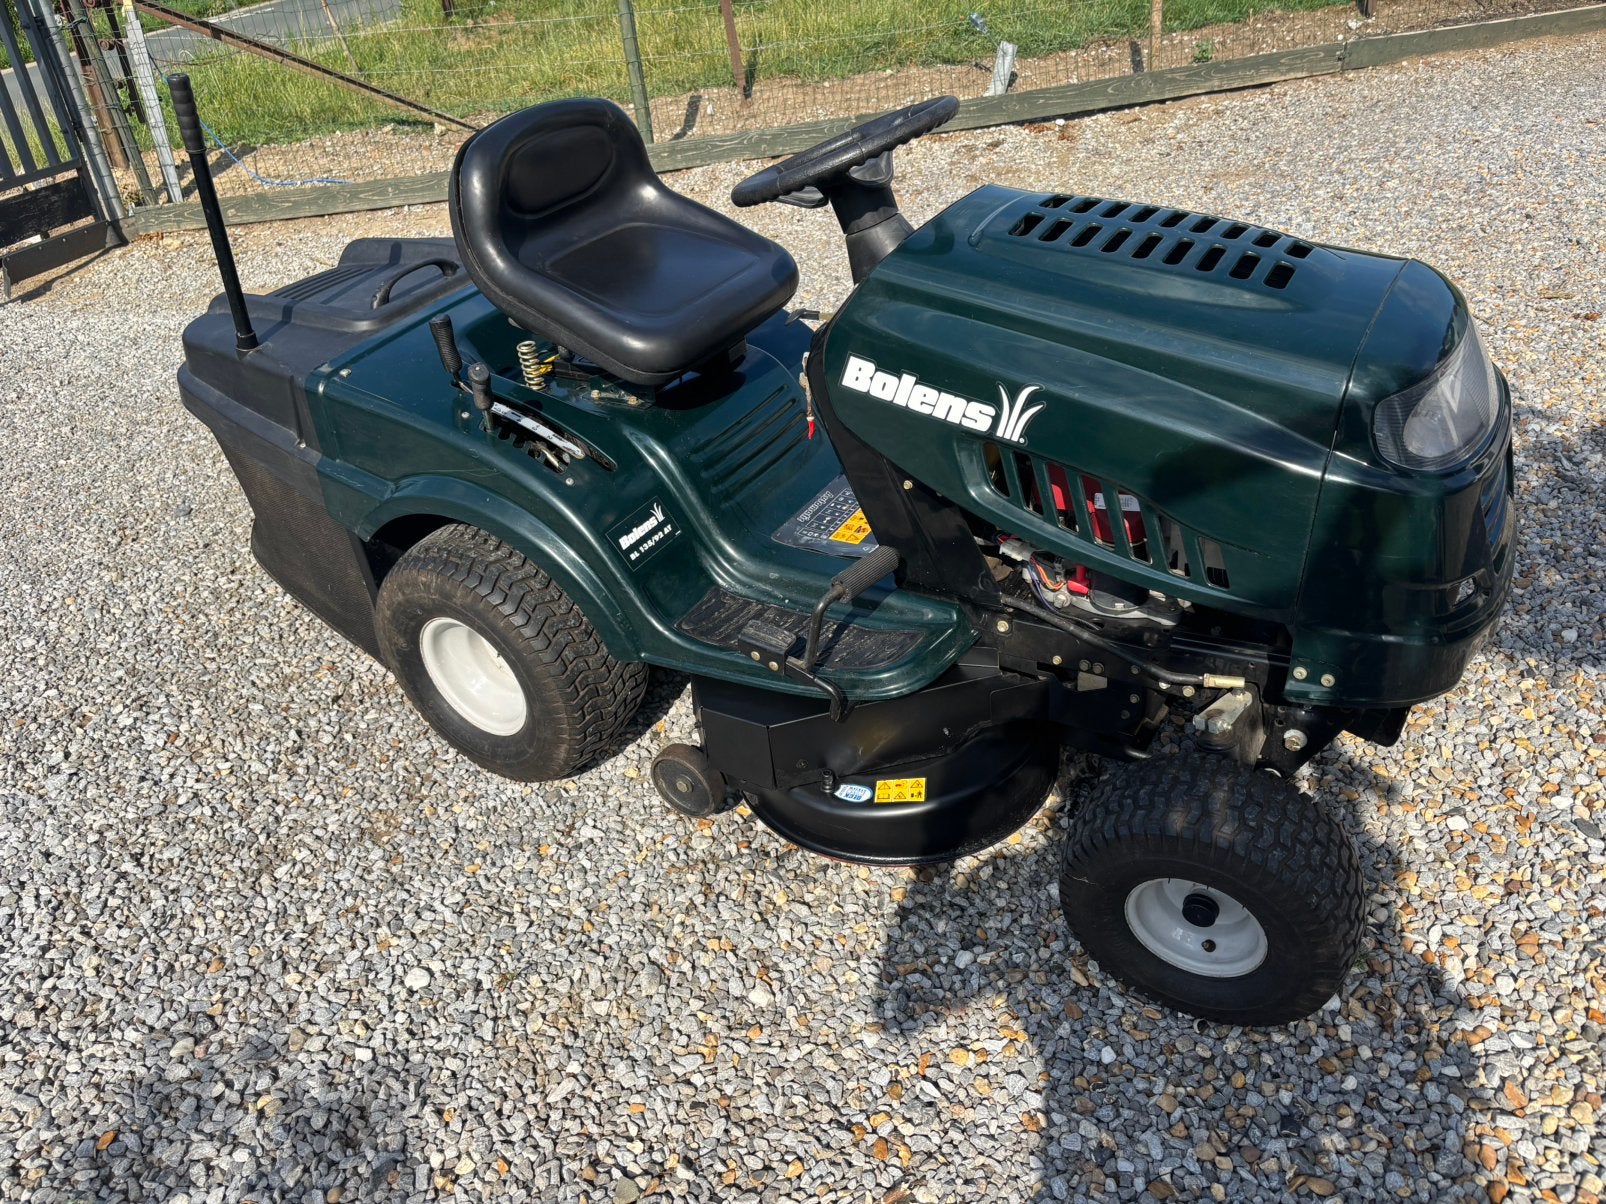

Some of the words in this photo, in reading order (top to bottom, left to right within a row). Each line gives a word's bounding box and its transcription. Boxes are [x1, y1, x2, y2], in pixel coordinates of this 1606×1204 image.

[842, 356, 996, 432] Bolens
[619, 516, 658, 550] Bolens
[629, 551, 640, 560] BL
[639, 532, 664, 552] 135/92
[664, 524, 672, 534] AT
